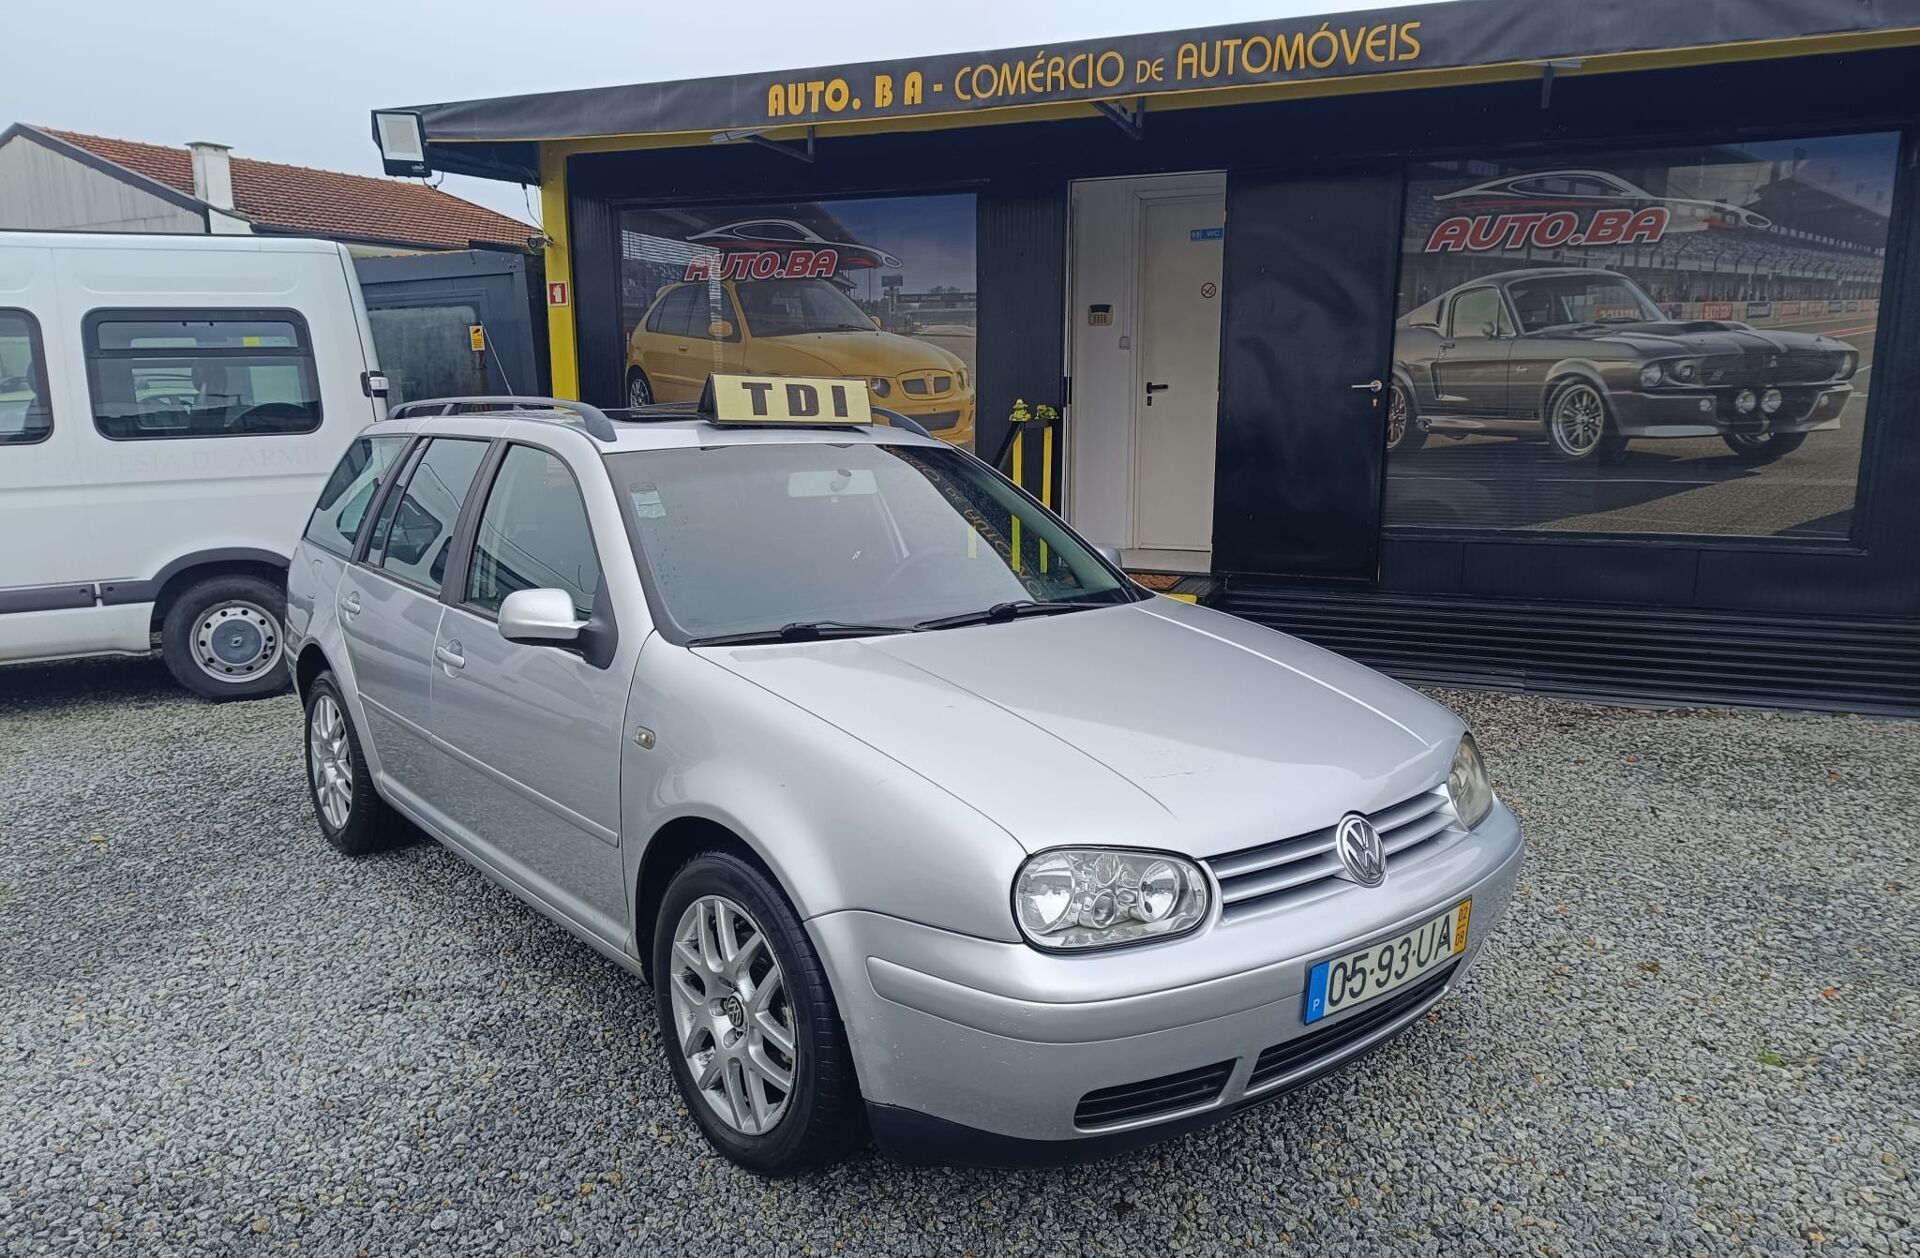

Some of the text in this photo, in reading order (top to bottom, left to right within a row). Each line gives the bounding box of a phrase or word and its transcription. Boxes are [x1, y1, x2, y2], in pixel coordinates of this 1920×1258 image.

[767, 78, 862, 117] AUTO.
[874, 75, 894, 108] B
[904, 71, 923, 106] A
[954, 50, 1125, 101] COMÉRCIO
[1136, 57, 1164, 84] DE
[1176, 21, 1421, 80] AUTOMÓVEIS
[1206, 229, 1220, 238] WC
[1424, 207, 1670, 252] AUTO.BA
[684, 249, 839, 282] AUTO.BA
[741, 381, 849, 418] TDI
[1312, 999, 1320, 1012] P
